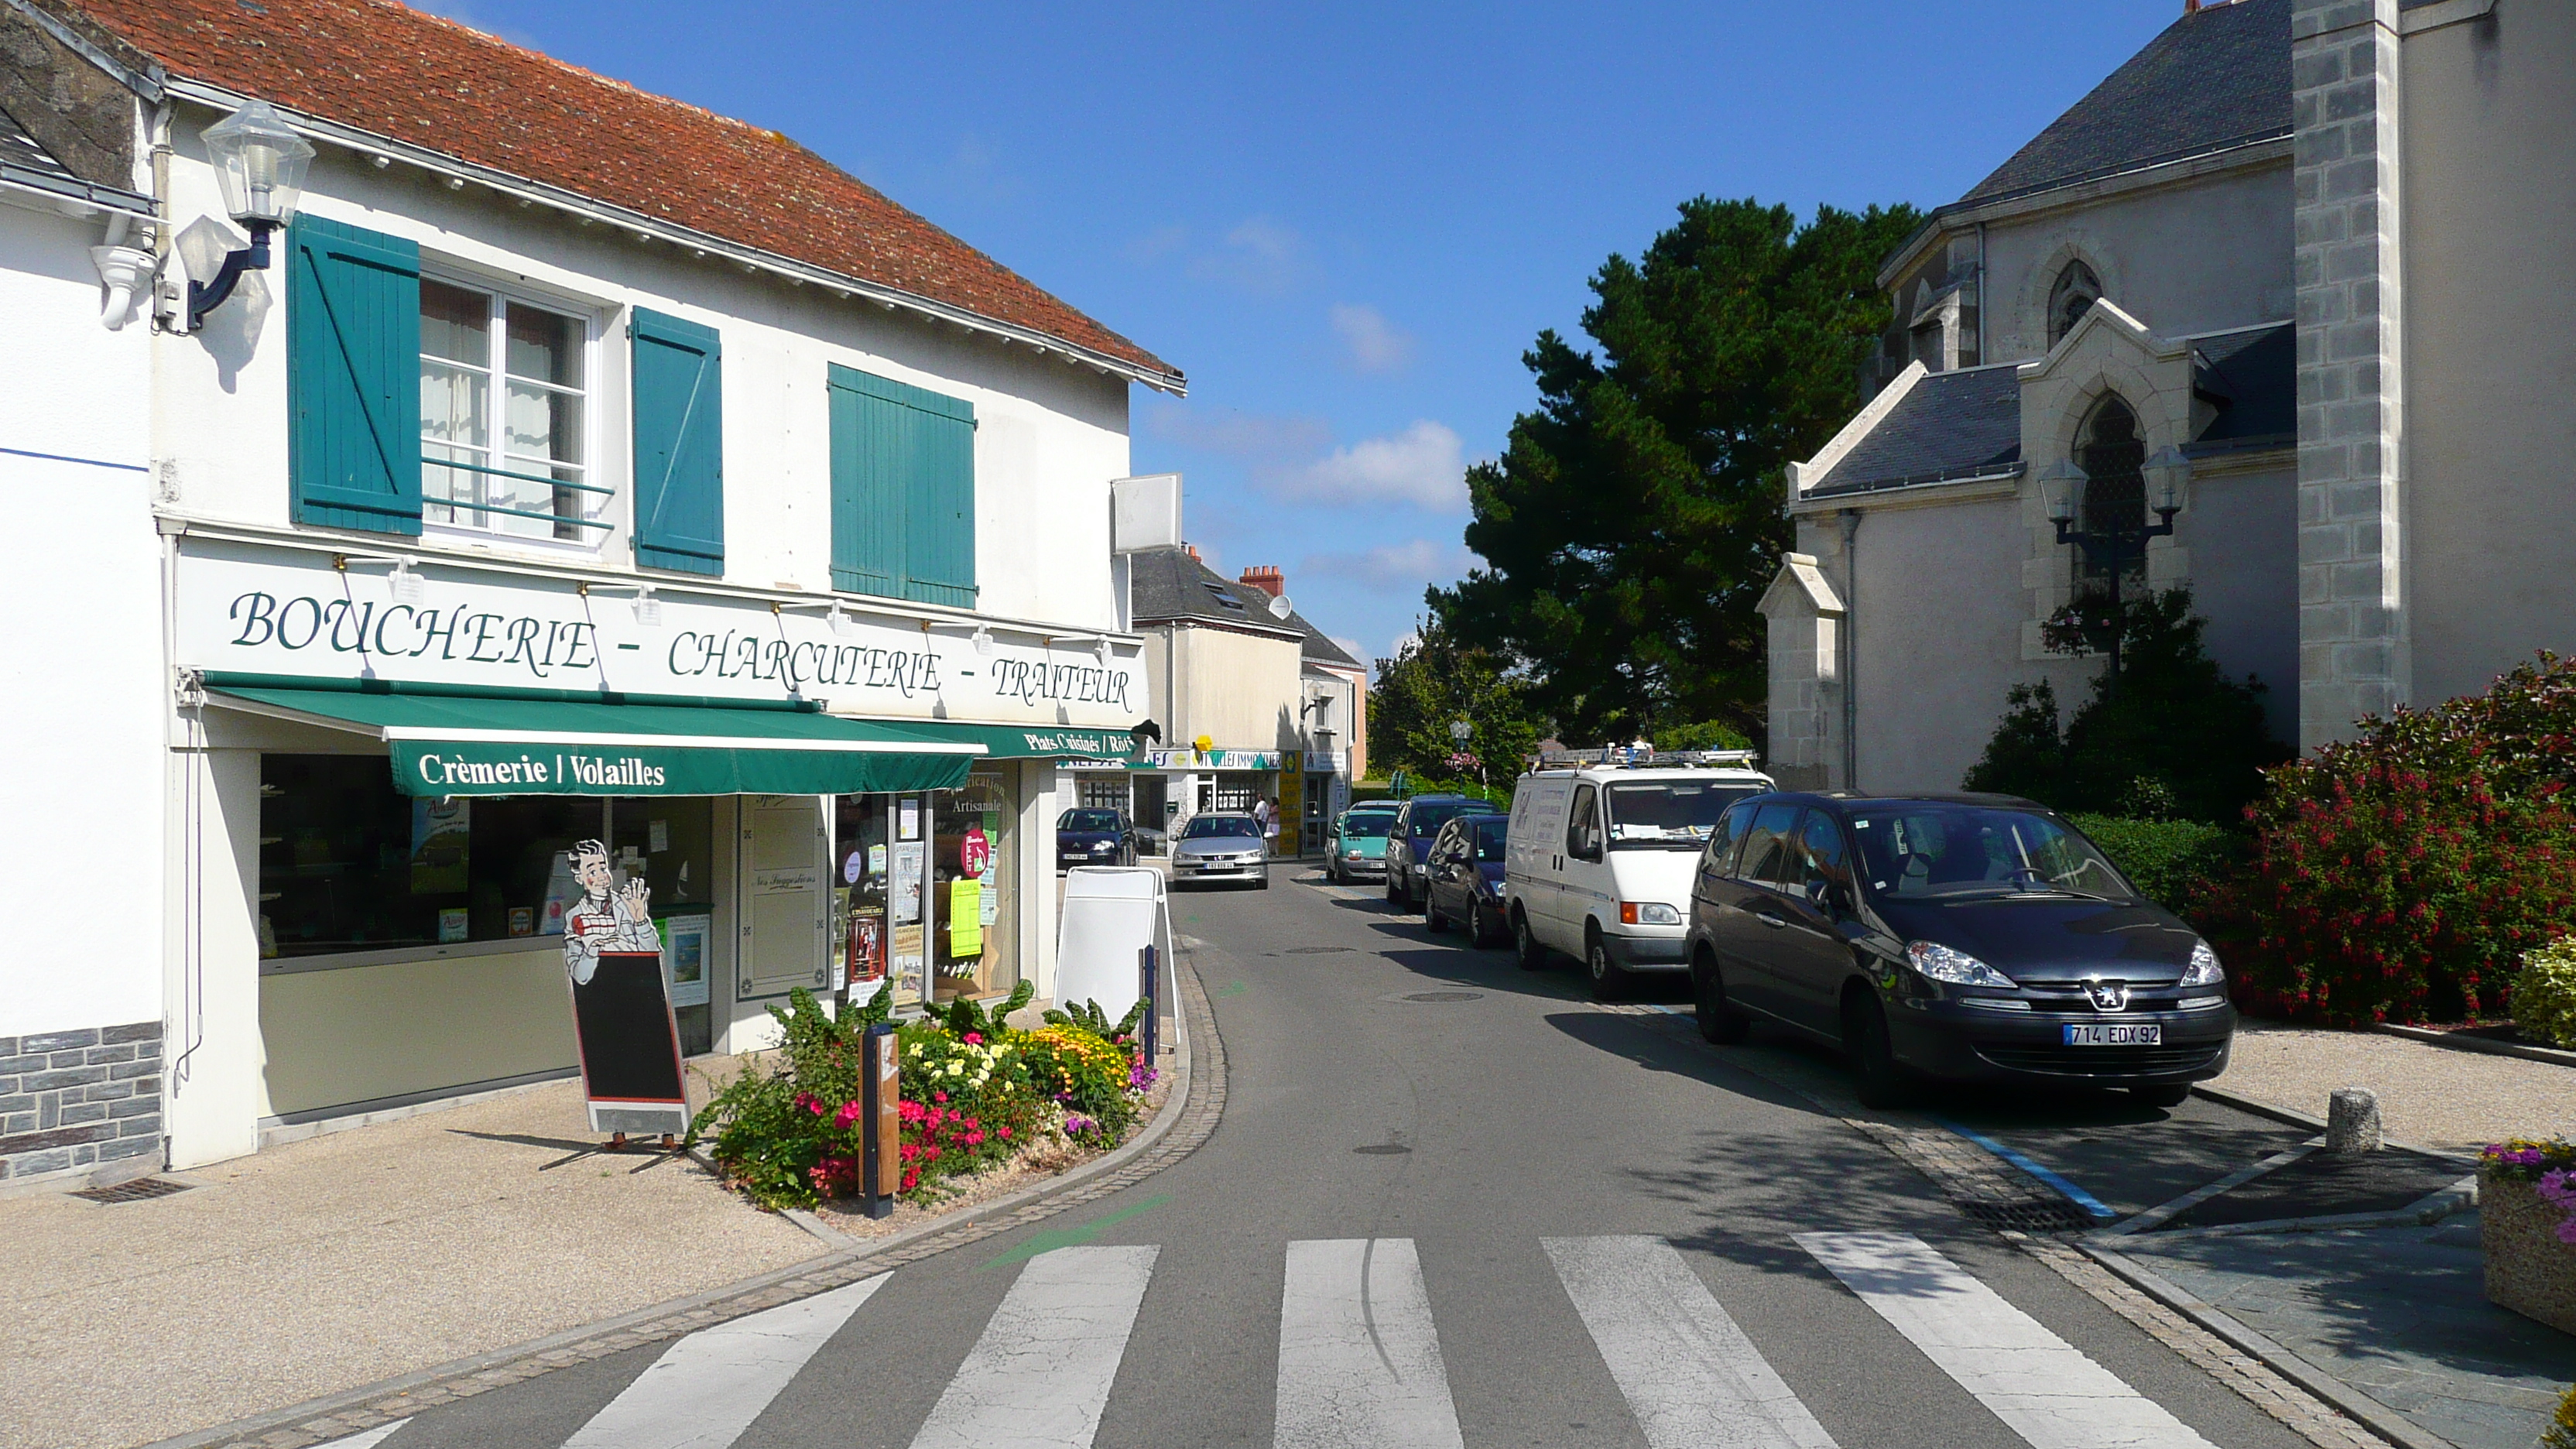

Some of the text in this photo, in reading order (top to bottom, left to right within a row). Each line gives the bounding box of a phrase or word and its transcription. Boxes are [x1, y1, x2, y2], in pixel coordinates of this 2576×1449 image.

[229, 591, 597, 678] BOUCHERIE
[668, 628, 942, 698] CHARCUTERIE
[991, 656, 1133, 714] TRAITEUR
[1023, 734, 1059, 752] Plats
[1057, 733, 1100, 753] Cuisinés
[419, 753, 549, 785] Crèmerie
[570, 755, 666, 787] Volailles
[952, 800, 1002, 813] Artisanale
[2072, 1027, 2159, 1043] 714 EDX 92
